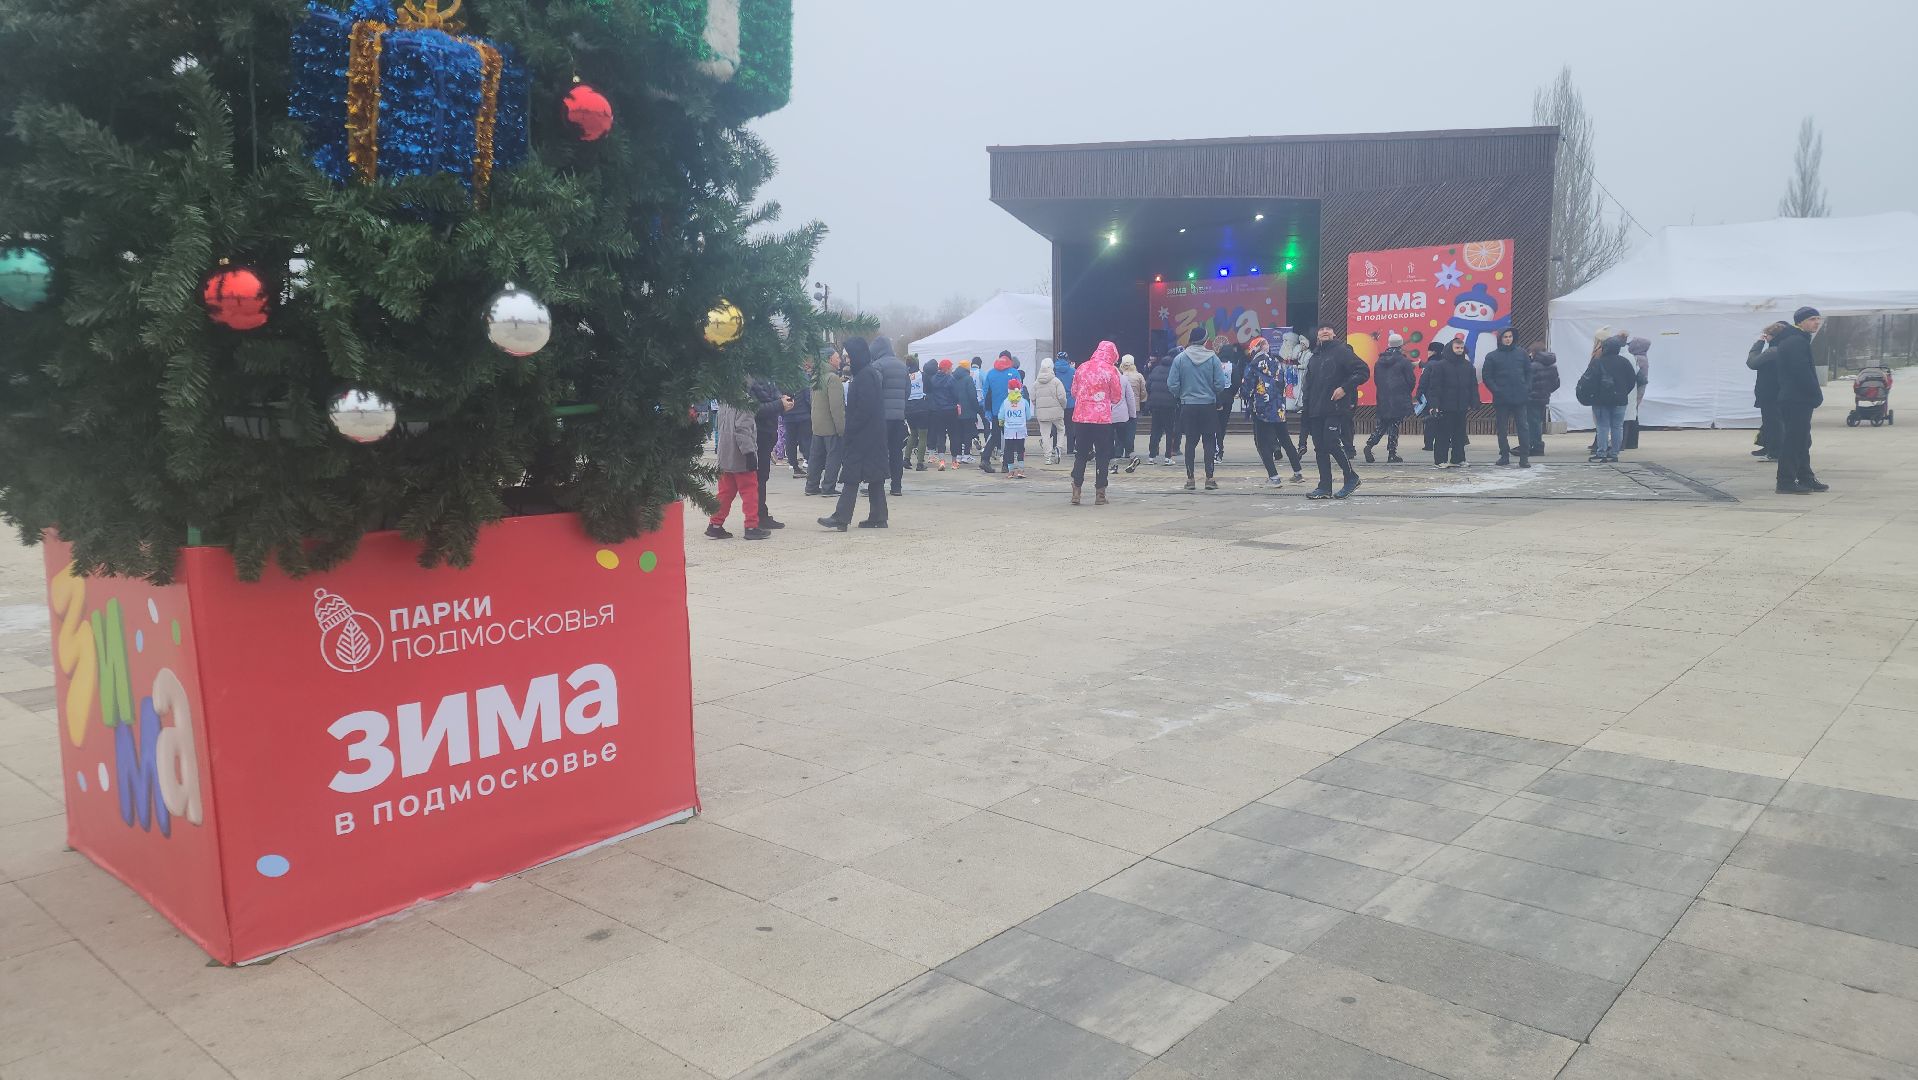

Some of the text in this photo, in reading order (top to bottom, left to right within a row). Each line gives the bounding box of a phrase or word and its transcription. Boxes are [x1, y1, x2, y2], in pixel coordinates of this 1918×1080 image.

[1357, 291, 1427, 314] зима
[1006, 409, 1022, 418] 082
[389, 595, 492, 632] ПАРКИ
[391, 604, 615, 662] ПОДМОСКОВЬЯ
[327, 663, 619, 793] зима
[335, 742, 617, 836] в подмосковье
